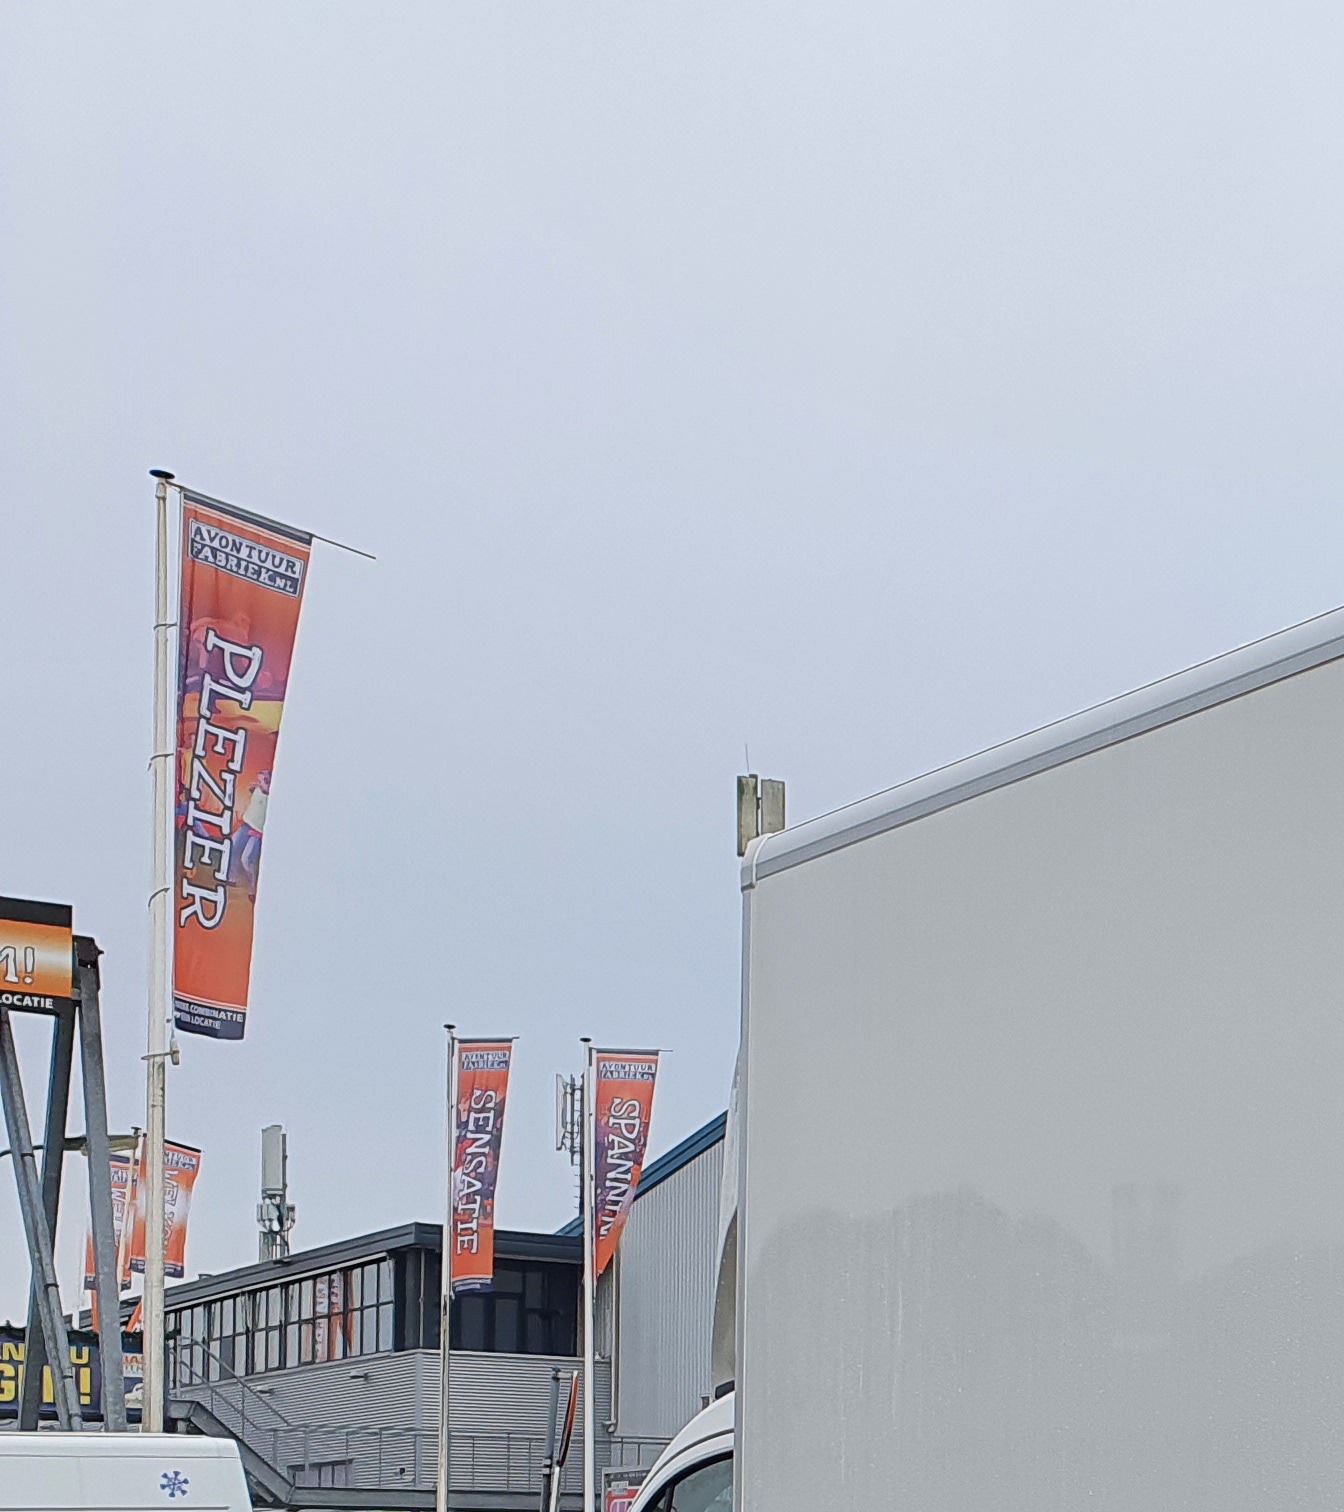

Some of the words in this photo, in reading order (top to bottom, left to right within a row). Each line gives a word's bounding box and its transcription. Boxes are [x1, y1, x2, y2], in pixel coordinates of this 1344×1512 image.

[192, 541, 296, 593] FABRIEK.NL
[193, 525, 298, 576] AVONTUUR
[179, 628, 263, 930] PLEZIER
[0, 993, 54, 1009] OCATIE
[456, 1088, 496, 1256] SENSATIE
